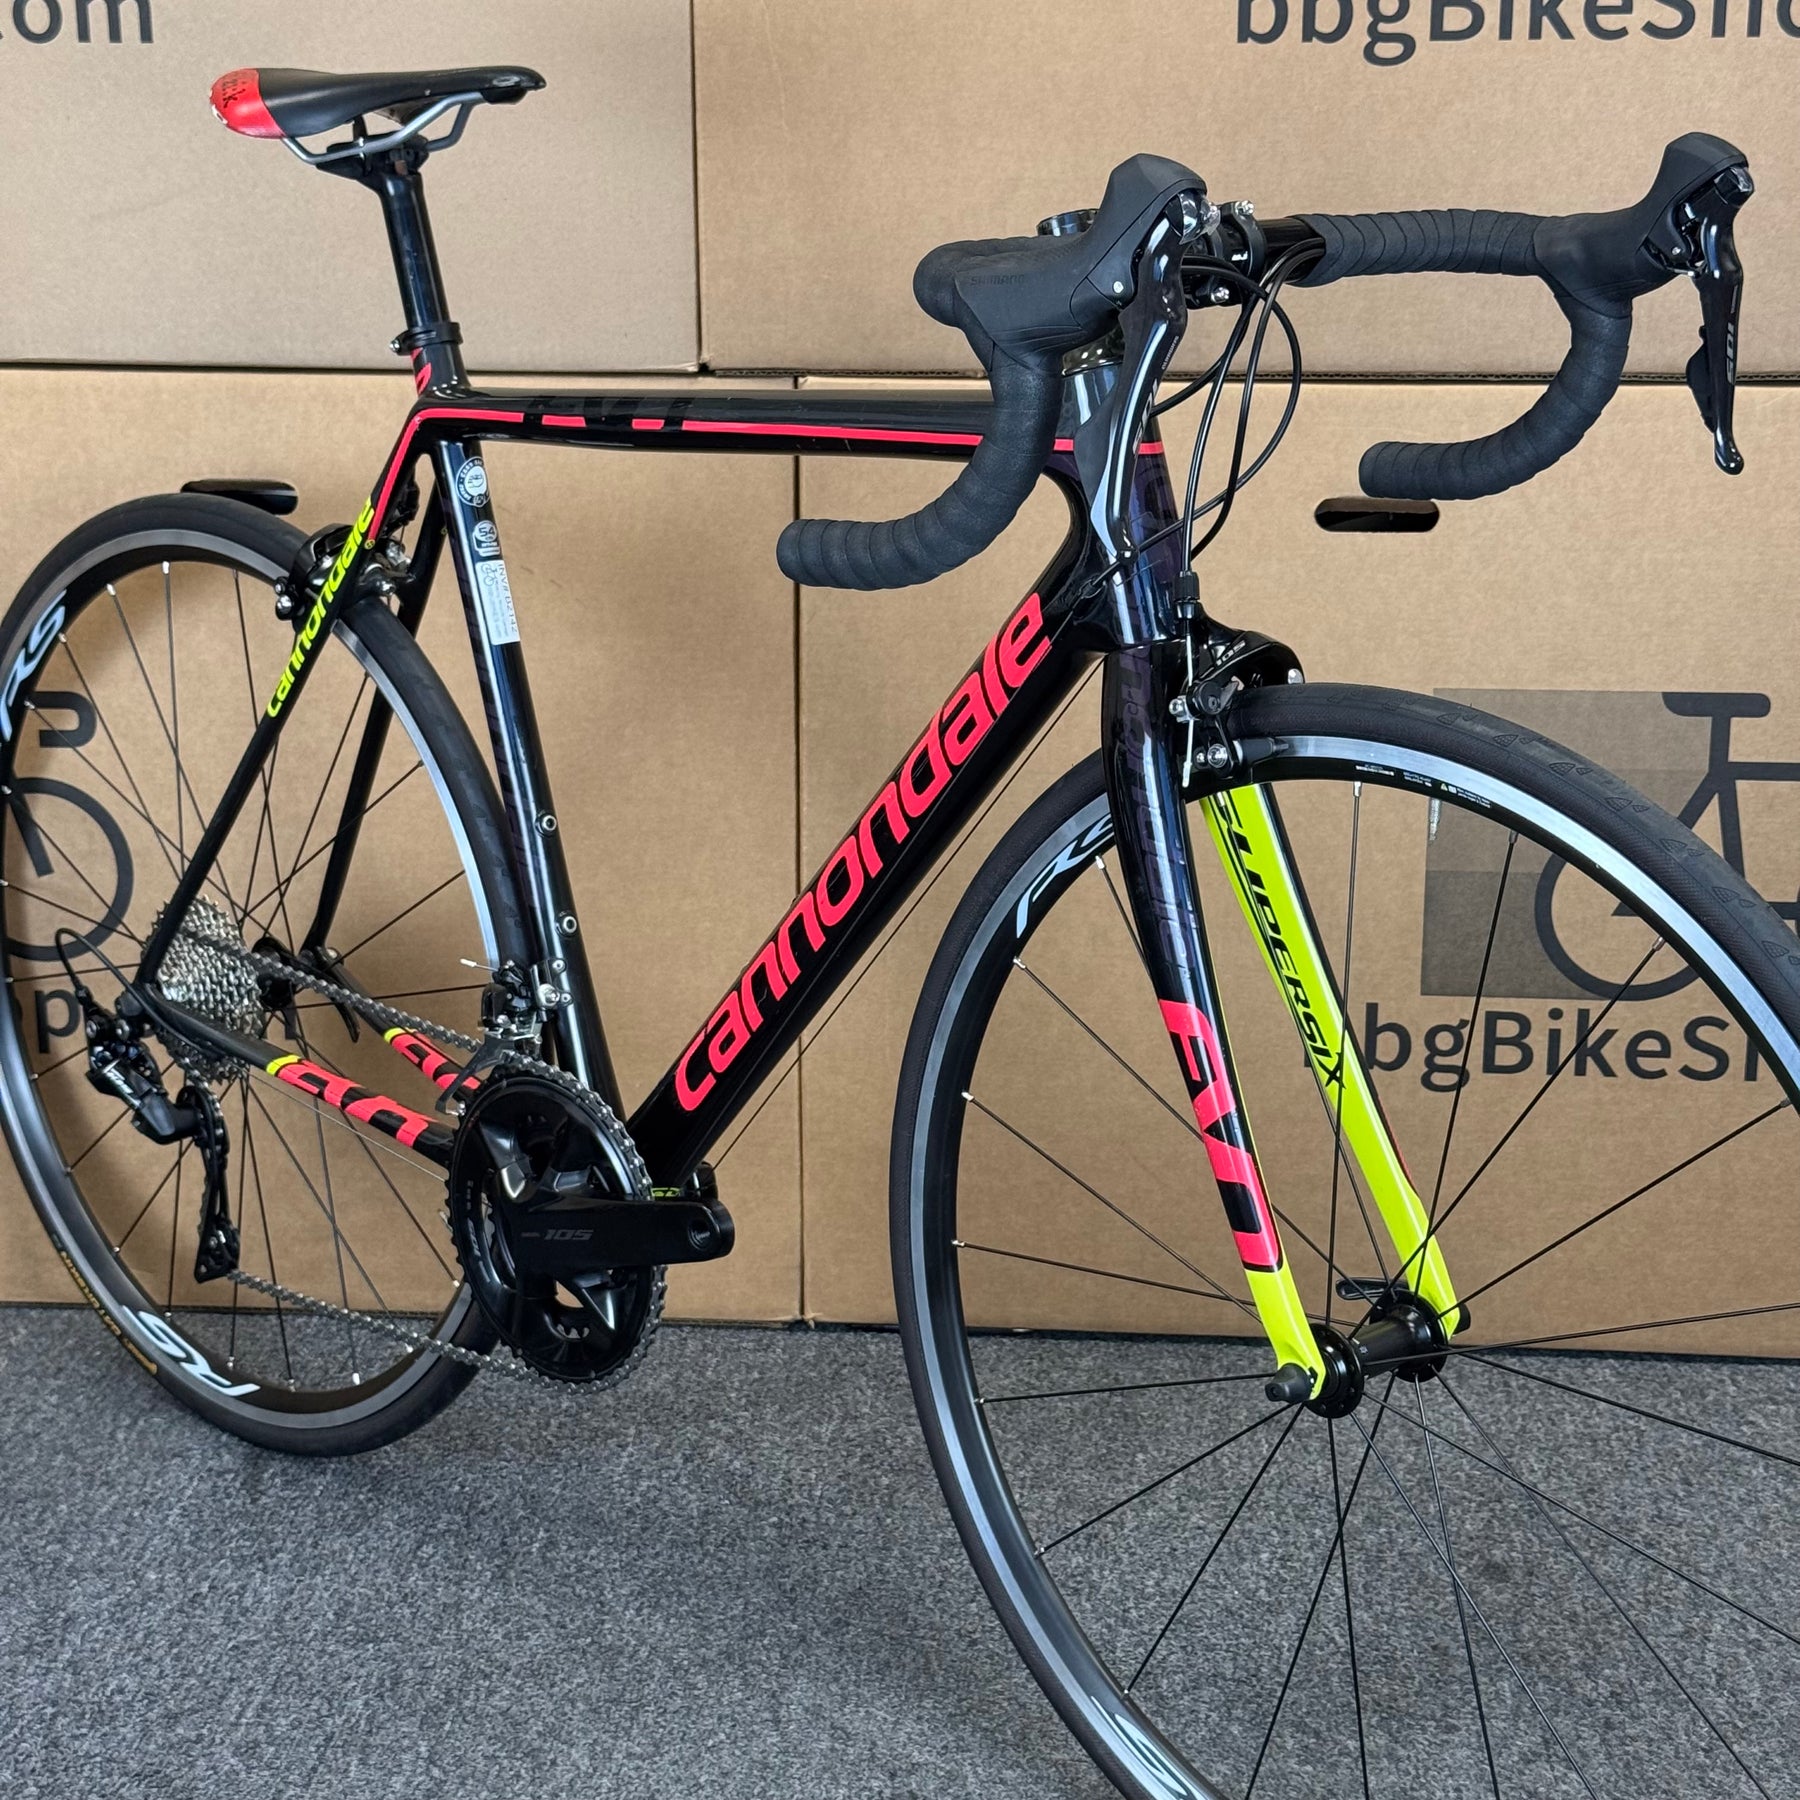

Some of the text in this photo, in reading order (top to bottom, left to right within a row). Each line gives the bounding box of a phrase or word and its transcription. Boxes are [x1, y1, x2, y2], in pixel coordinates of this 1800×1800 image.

[0, 0, 154, 44] om
[267, 498, 374, 718] cannondale
[1216, 640, 1246, 666] 105
[675, 592, 1052, 1111] cannondale
[1304, 1002, 1762, 1092] bgBikeS
[543, 1228, 594, 1241] 105
